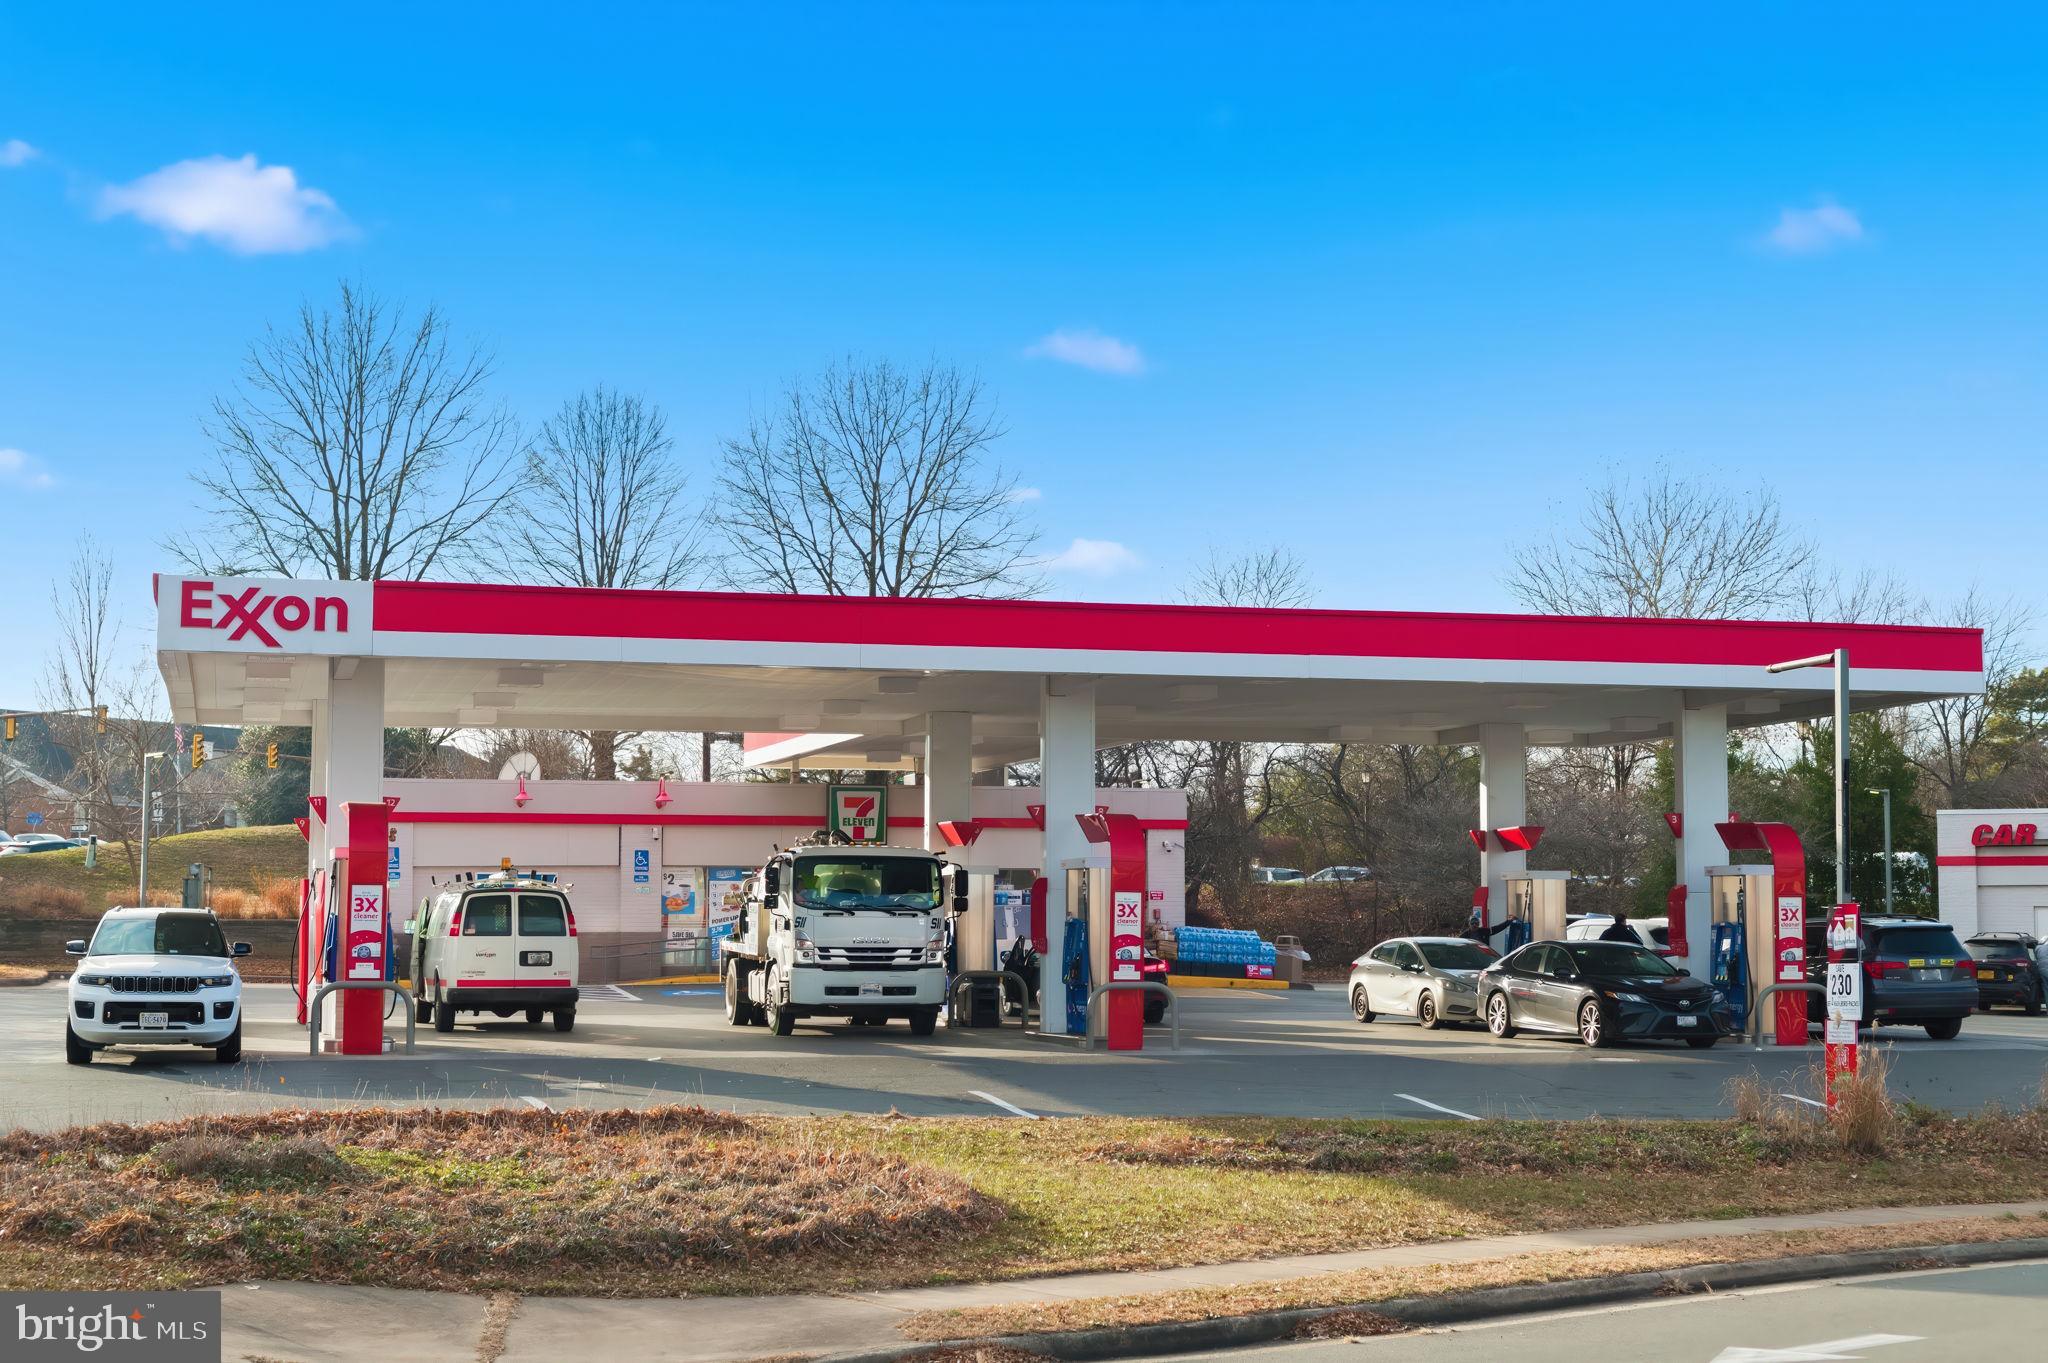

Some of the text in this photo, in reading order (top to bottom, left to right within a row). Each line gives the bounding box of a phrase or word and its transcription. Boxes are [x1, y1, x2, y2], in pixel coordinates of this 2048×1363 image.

[180, 581, 348, 648] Exxon
[386, 799, 396, 807] 12
[844, 797, 874, 839] 7
[1033, 807, 1040, 816] 7
[300, 819, 306, 828] 9
[1671, 815, 1678, 824] 3
[1729, 815, 1735, 824] 4
[1971, 824, 2038, 847] CAR
[353, 897, 379, 913] 3X
[1117, 903, 1138, 918] 3X
[1780, 908, 1800, 922] 3X
